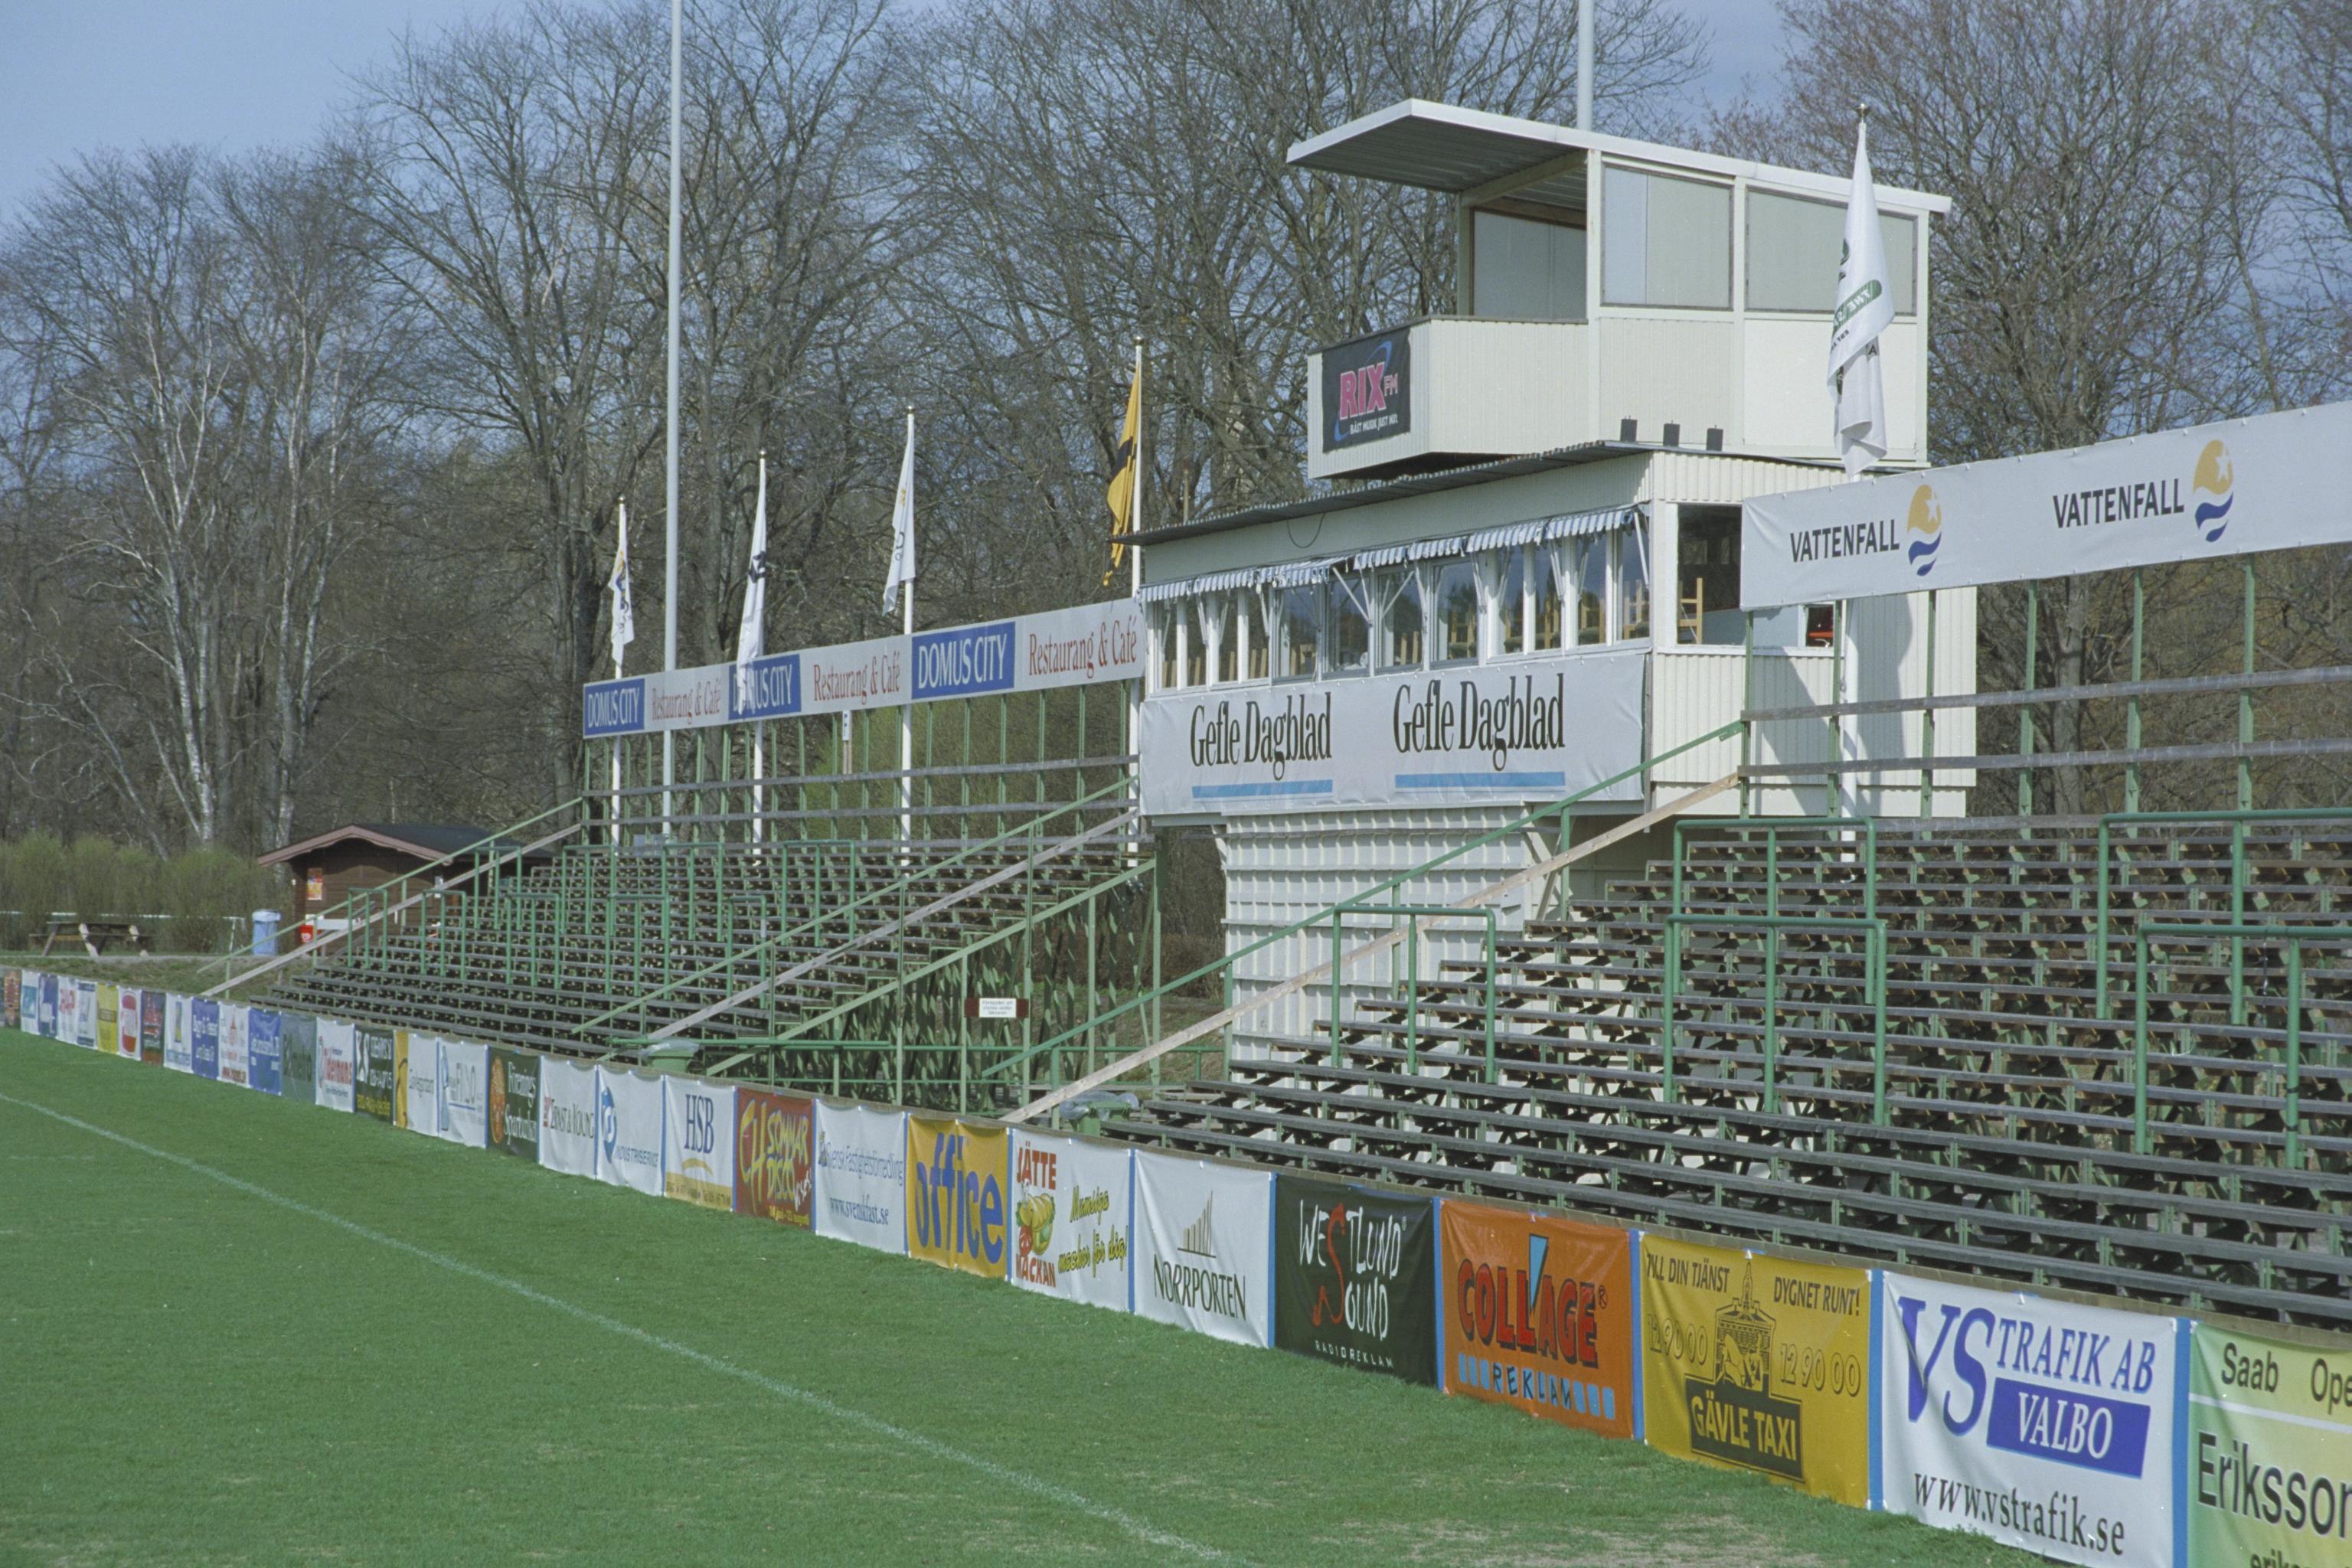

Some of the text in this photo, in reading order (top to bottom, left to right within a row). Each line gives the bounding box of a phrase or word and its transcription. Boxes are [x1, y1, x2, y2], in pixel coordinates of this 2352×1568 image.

[1340, 361, 1398, 420] RIX FM
[2053, 478, 2185, 528] VATTENFALL
[1790, 518, 1900, 564] VATTENFALL
[918, 632, 1007, 690] DOMUS CITY
[1029, 615, 1138, 679] Restaurang & Café
[652, 688, 693, 725] Restaurang
[704, 678, 721, 715] Café
[771, 664, 792, 707] CITY
[814, 650, 900, 705] Restaurang & Café
[588, 688, 639, 727] DOMUS CITY
[1393, 672, 1566, 772] Gefle Dagblad
[1191, 691, 1332, 781] Gefle Dagblad
[550, 1099, 567, 1133] ERNST
[572, 1102, 594, 1139] YOUNG
[684, 1093, 714, 1155] HSB
[767, 1109, 809, 1165] SOMMAR
[766, 1157, 795, 1200] DISCO
[1017, 1141, 1057, 1190] JÄTTE
[829, 1194, 889, 1225] www.svenskfast.se
[915, 1132, 1004, 1264] office
[1016, 1253, 1057, 1288] MACKAN
[1154, 1254, 1246, 1320] NORRPORTEN
[1647, 1252, 1730, 1292] TILL DIN TJÄNST
[1774, 1276, 1860, 1316] DYGNET RUNT!
[1315, 1340, 1393, 1369] RADIOREKLAM
[1648, 1313, 1708, 1365] 12 90 00
[1997, 1318, 2156, 1394] TRAFIK AB
[1493, 1363, 1573, 1410] REKLAM
[1780, 1343, 1861, 1397] 12 90 00
[1897, 1296, 1997, 1437] VS
[2221, 1341, 2279, 1393] Saab
[1690, 1390, 1797, 1461] GÄVLE TAXI
[2017, 1391, 2113, 1459] VALBO
[1914, 1472, 2125, 1556] www.vstrafik.se
